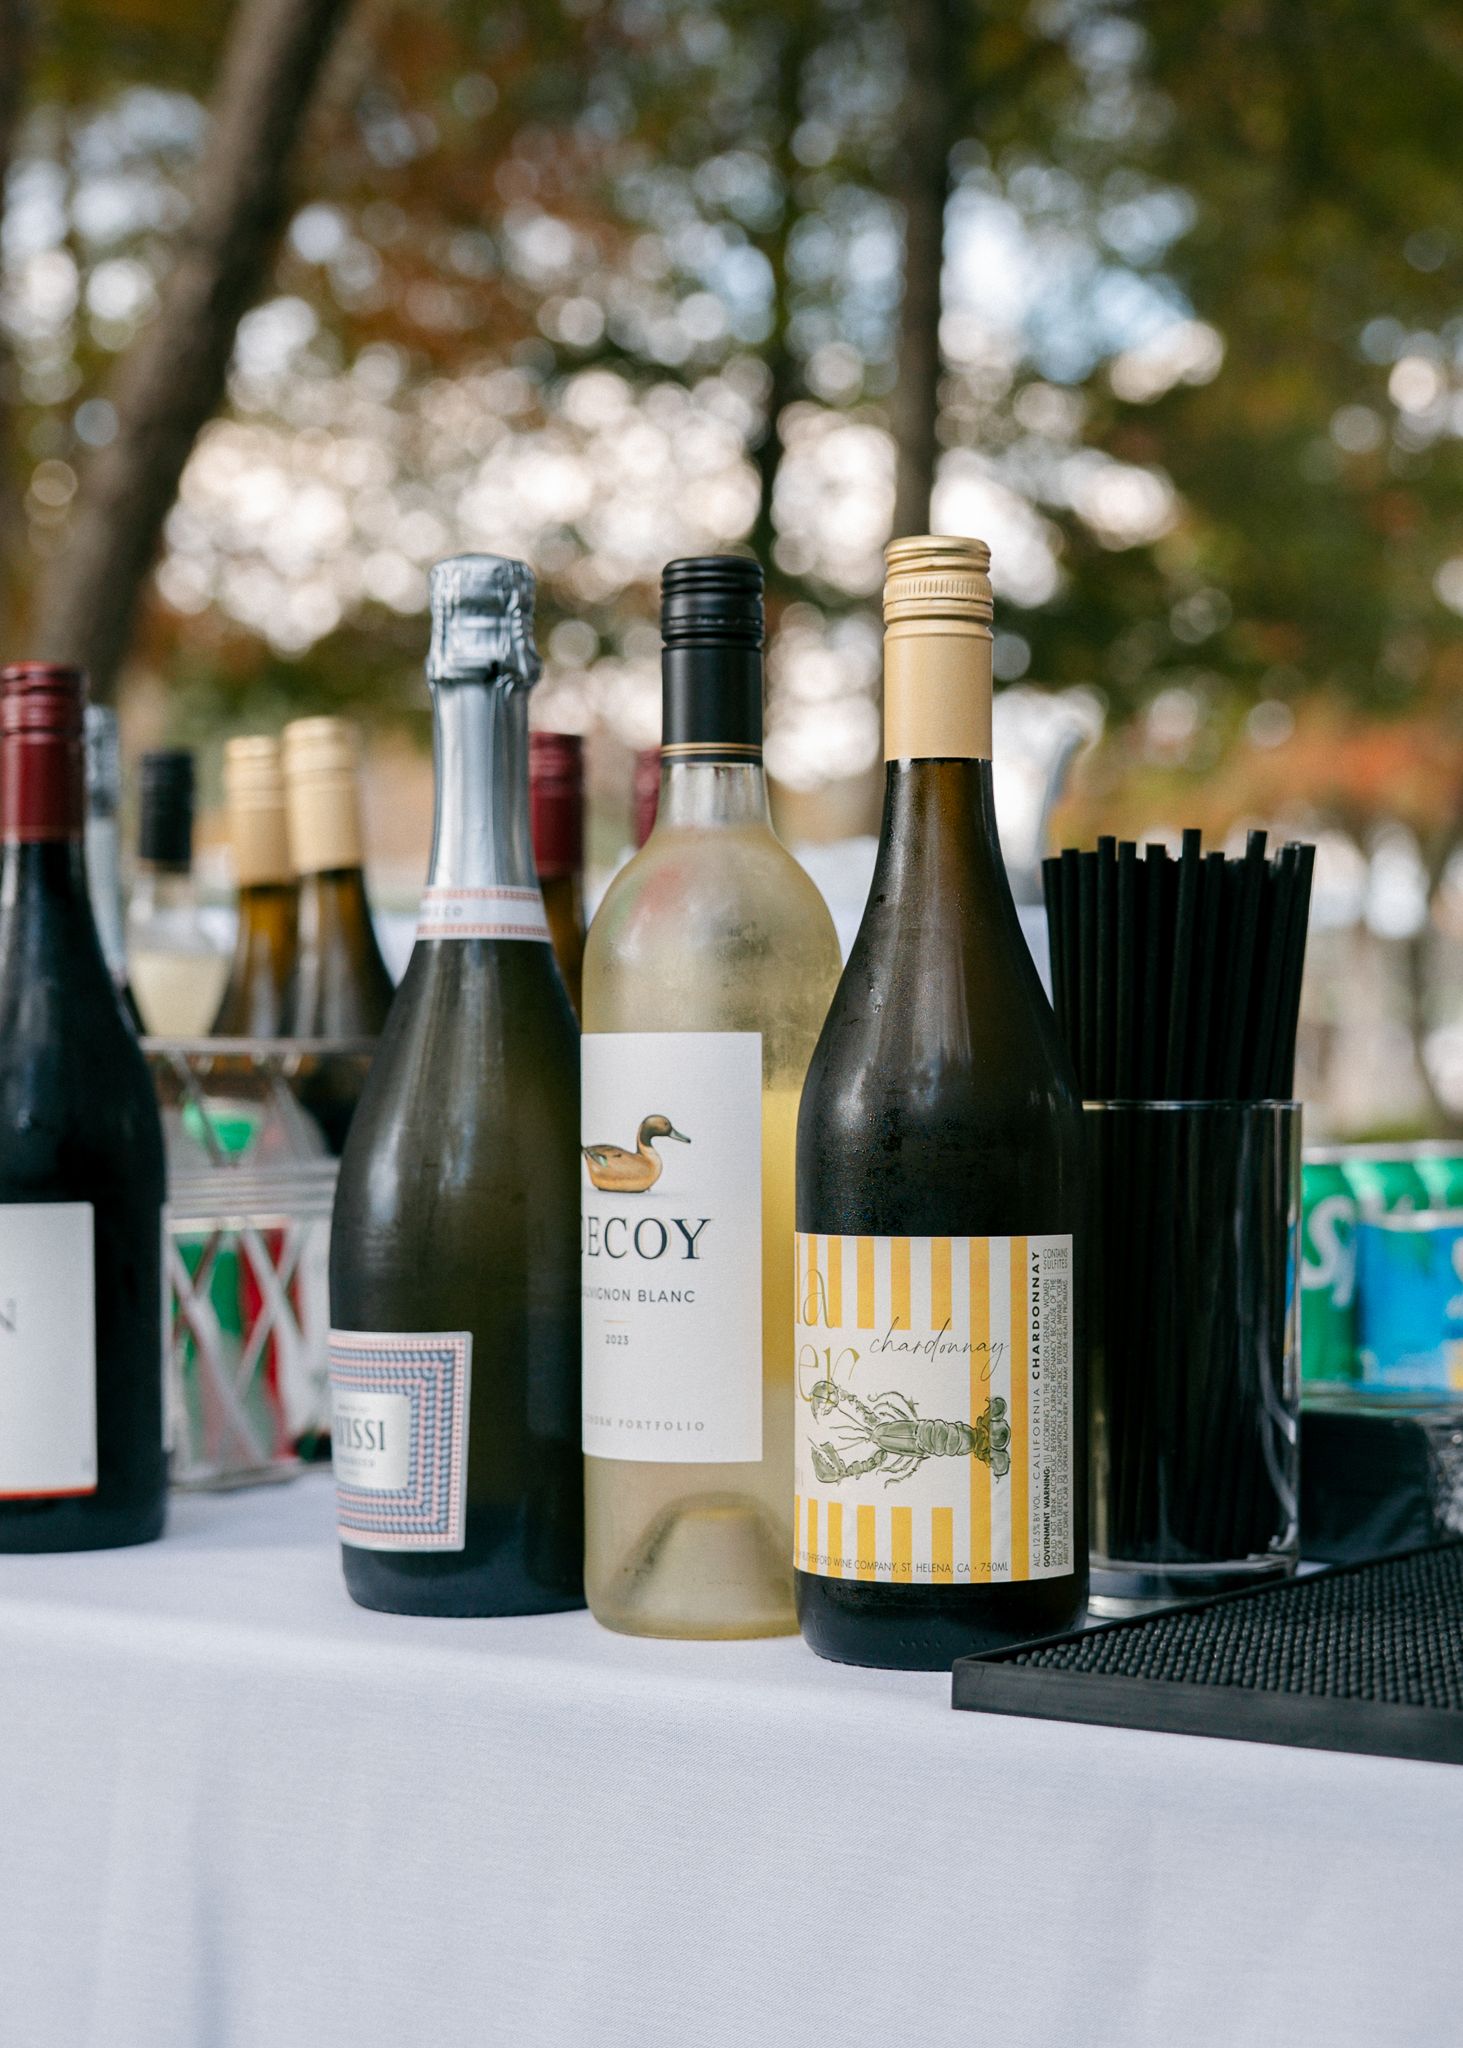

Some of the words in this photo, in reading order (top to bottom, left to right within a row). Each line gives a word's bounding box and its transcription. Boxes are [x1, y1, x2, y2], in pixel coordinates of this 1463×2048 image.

[581, 1216, 711, 1260] ECOY
[1043, 1248, 1068, 1258] CONTAINS
[1043, 1259, 1068, 1270] SULFITES
[637, 1289, 696, 1303] BLANC
[1050, 1294, 1057, 1304] OF
[1032, 1251, 1040, 1380] CHARDONNAY
[869, 1316, 1010, 1382] chardonnay
[1043, 1397, 1050, 1407] TO
[1057, 1409, 1063, 1418] OF
[619, 1419, 705, 1431] PORTFOLIO
[1032, 1388, 1041, 1480] CALIFORNIA
[1033, 1512, 1041, 1522] BY
[1057, 1540, 1063, 1550] OF
[833, 1558, 853, 1568] WINE
[854, 1559, 898, 1573] COMPANY,
[901, 1563, 913, 1572] ST.
[916, 1563, 954, 1574] HELENA,
[957, 1563, 970, 1573] CA
[980, 1562, 1008, 1572] 750ML
